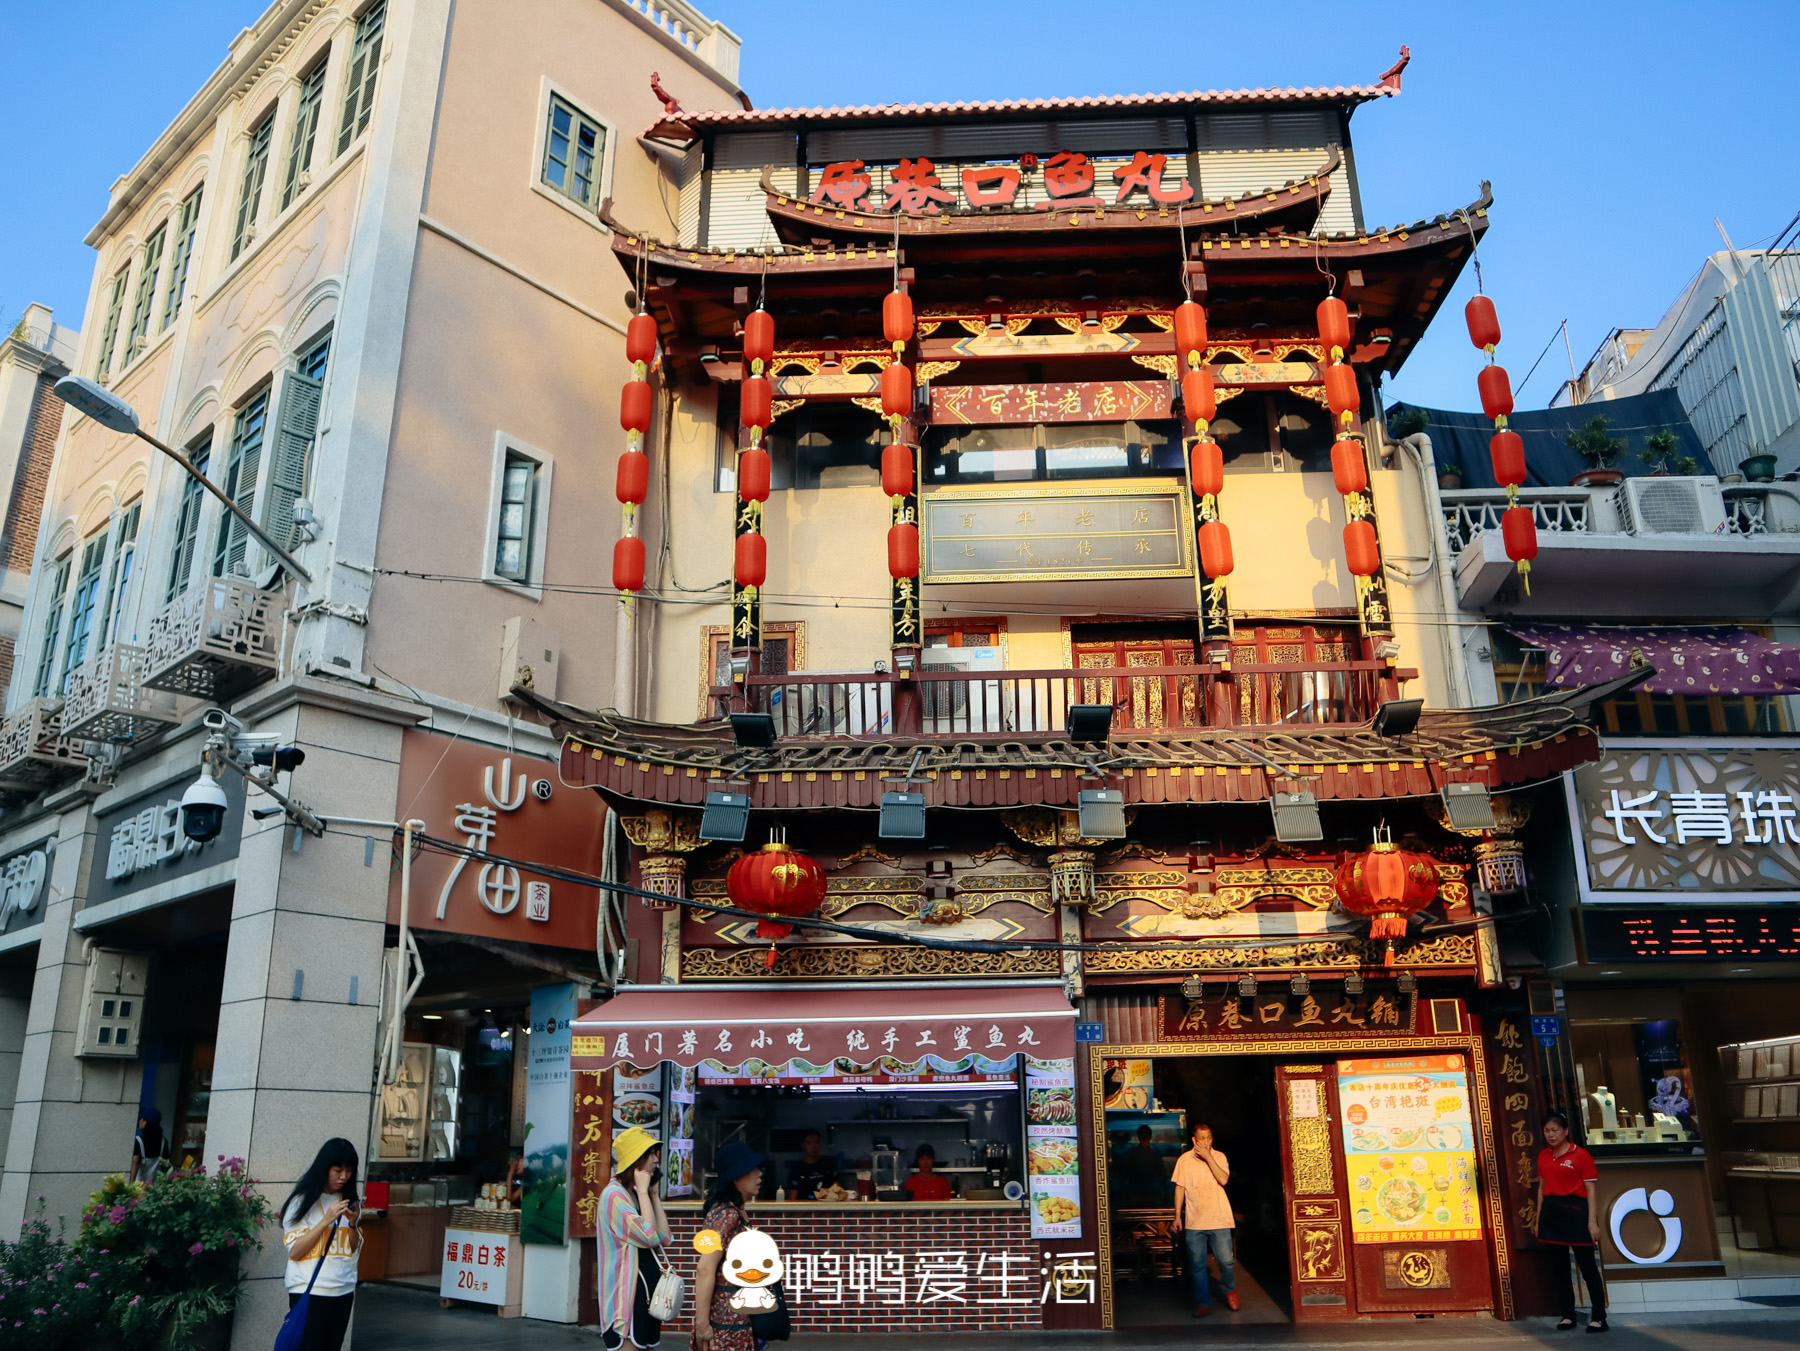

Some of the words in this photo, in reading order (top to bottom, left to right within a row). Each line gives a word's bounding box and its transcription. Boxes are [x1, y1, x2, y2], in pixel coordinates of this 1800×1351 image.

[981, 386, 1117, 417] 百年老店
[959, 506, 1151, 528] 百年老店
[960, 537, 1151, 557] 七代传承
[1605, 790, 1800, 845] 长青珠
[105, 799, 214, 880] 福鼎白
[533, 884, 547, 918] 茶业
[612, 1028, 810, 1058] 厦门著名小吃
[846, 1025, 1041, 1052] 纯手工鲨鱼丸
[1541, 1024, 1546, 1033] 5
[447, 1241, 506, 1267] 福鼎白茶
